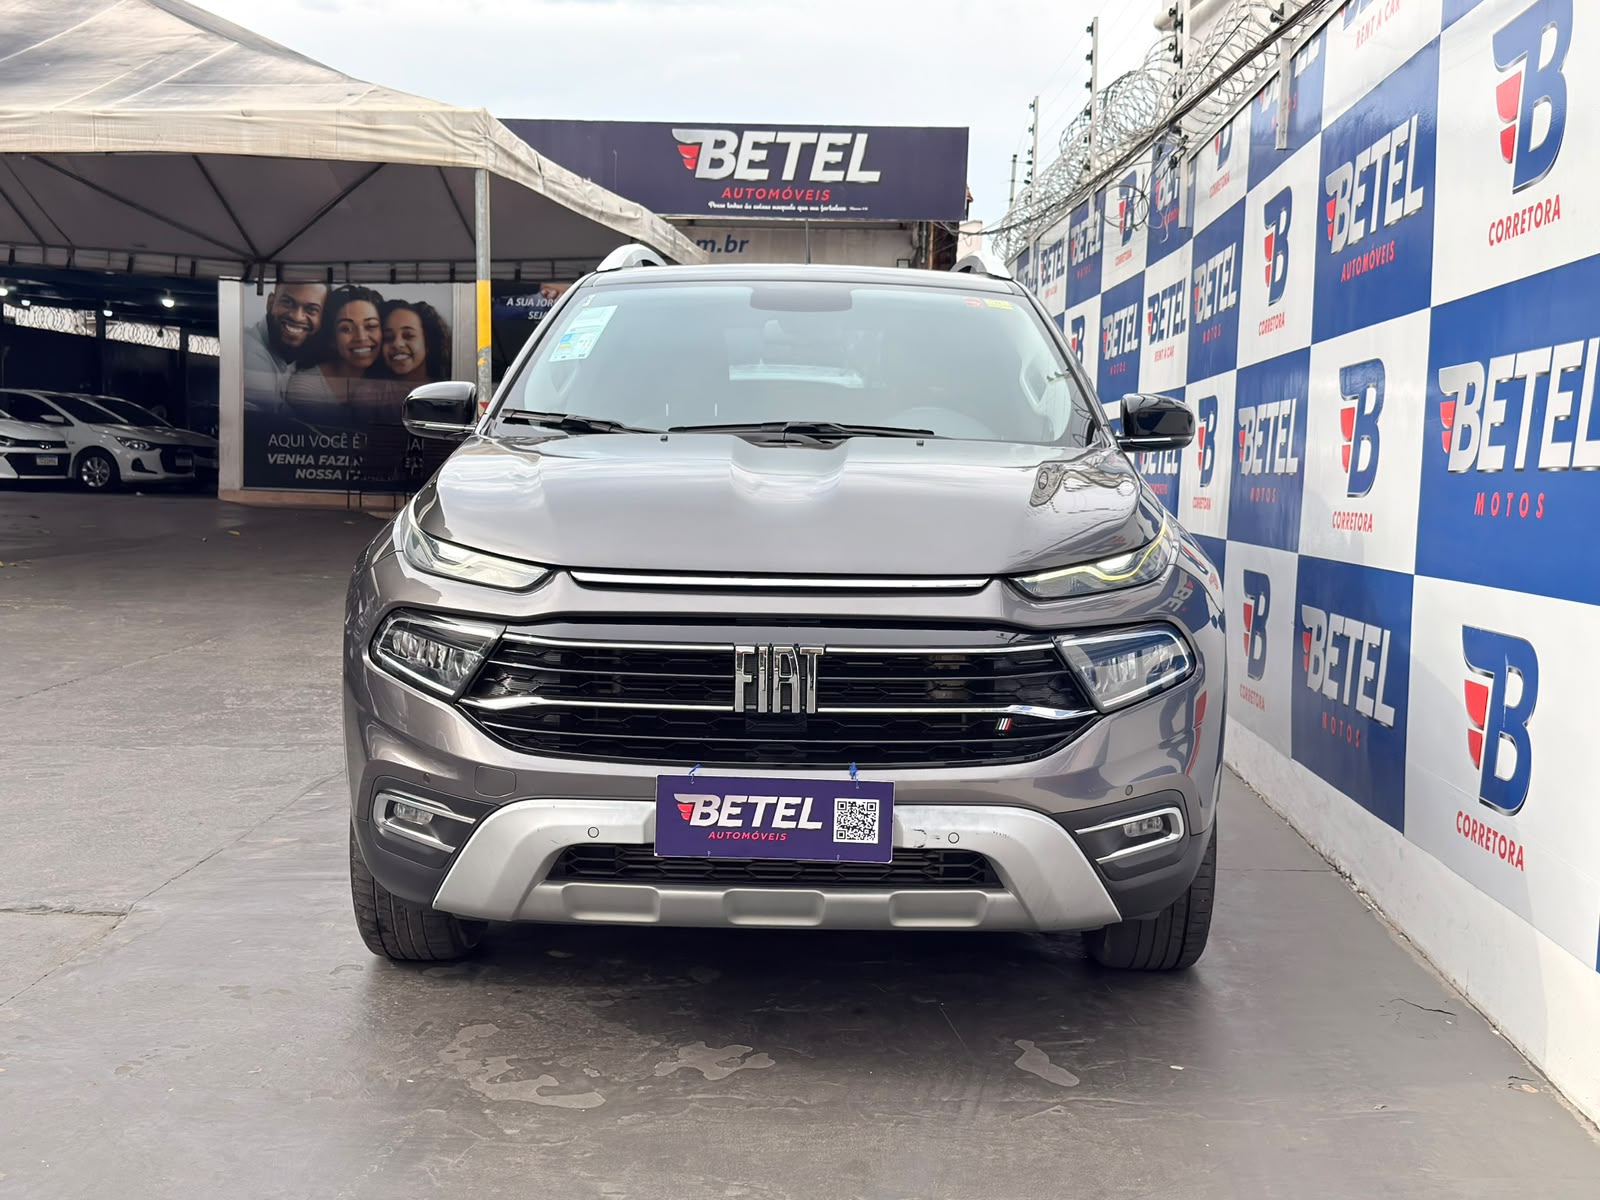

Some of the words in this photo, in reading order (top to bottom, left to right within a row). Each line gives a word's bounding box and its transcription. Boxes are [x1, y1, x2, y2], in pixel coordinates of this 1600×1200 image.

[672, 128, 881, 183] BETEL
[721, 186, 831, 201] AUTOMÓVEIS
[1325, 113, 1424, 255] BETEL
[1488, 194, 1561, 247] CORRETORA
[1340, 239, 1395, 283] AUTOMÓVEIS
[506, 297, 514, 307] A
[515, 298, 535, 307] SUA
[535, 298, 557, 307] JOR
[1194, 243, 1237, 325] BETEL
[1147, 278, 1186, 345] BETEL
[1258, 311, 1286, 337] CORRETORA
[1102, 302, 1139, 361] BETEL
[1438, 336, 1600, 474] BETEL
[268, 433, 305, 449] AQUI
[309, 432, 348, 449] VOCÊ
[1238, 398, 1298, 476] BETEL
[268, 453, 315, 465] VENHA
[295, 468, 342, 480] NOSSA
[1250, 487, 1277, 503] MOTOS
[1473, 491, 1545, 519] MOTOS
[1331, 511, 1373, 533] CORRETORA
[734, 645, 825, 714] FIAT
[1301, 604, 1395, 728] BETEL
[1239, 683, 1266, 712] CORRETORA
[1322, 711, 1361, 748] MOTOS
[673, 792, 823, 830] BETEL
[708, 830, 788, 842] AUTOMÓVEIS
[1456, 810, 1524, 872] CORRETORA
